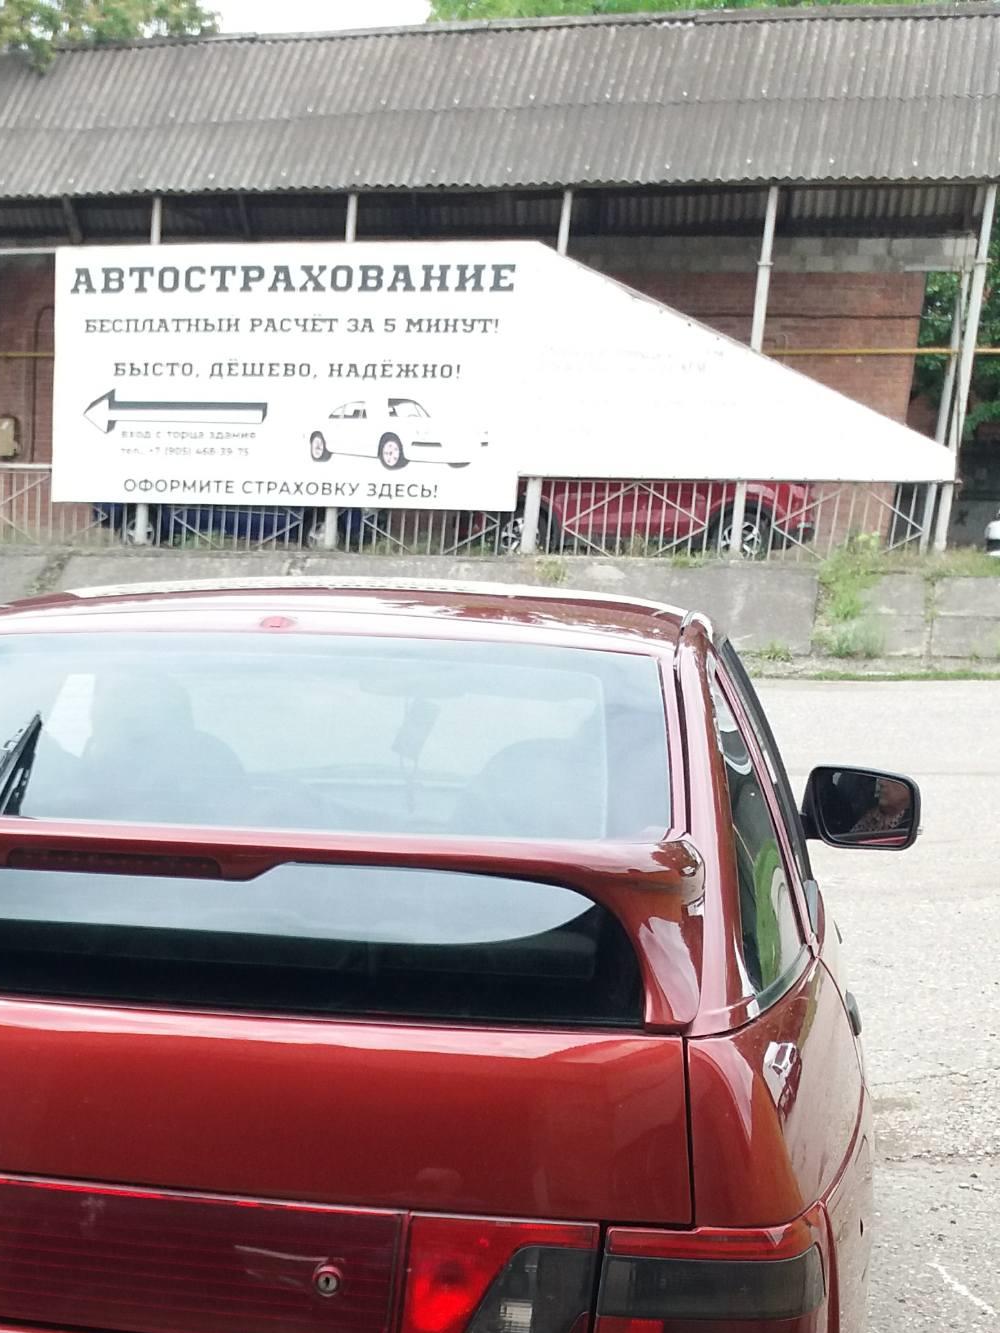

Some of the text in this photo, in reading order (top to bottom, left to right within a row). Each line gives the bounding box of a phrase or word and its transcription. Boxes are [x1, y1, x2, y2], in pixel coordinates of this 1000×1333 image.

[69, 264, 517, 294] АВТОСТРАХОВАНИЕ
[84, 313, 500, 334] БЕСПЛАТНЫЙ РАСЧЁТ ЗА 5 МИНУТ!
[113, 358, 461, 380] БЫСТО, ДЁШЕВО, НАДЁЖНО!
[123, 478, 438, 500] ОФОРМИТЕ СТРАХОВКУ ЗДЕСЬ!
